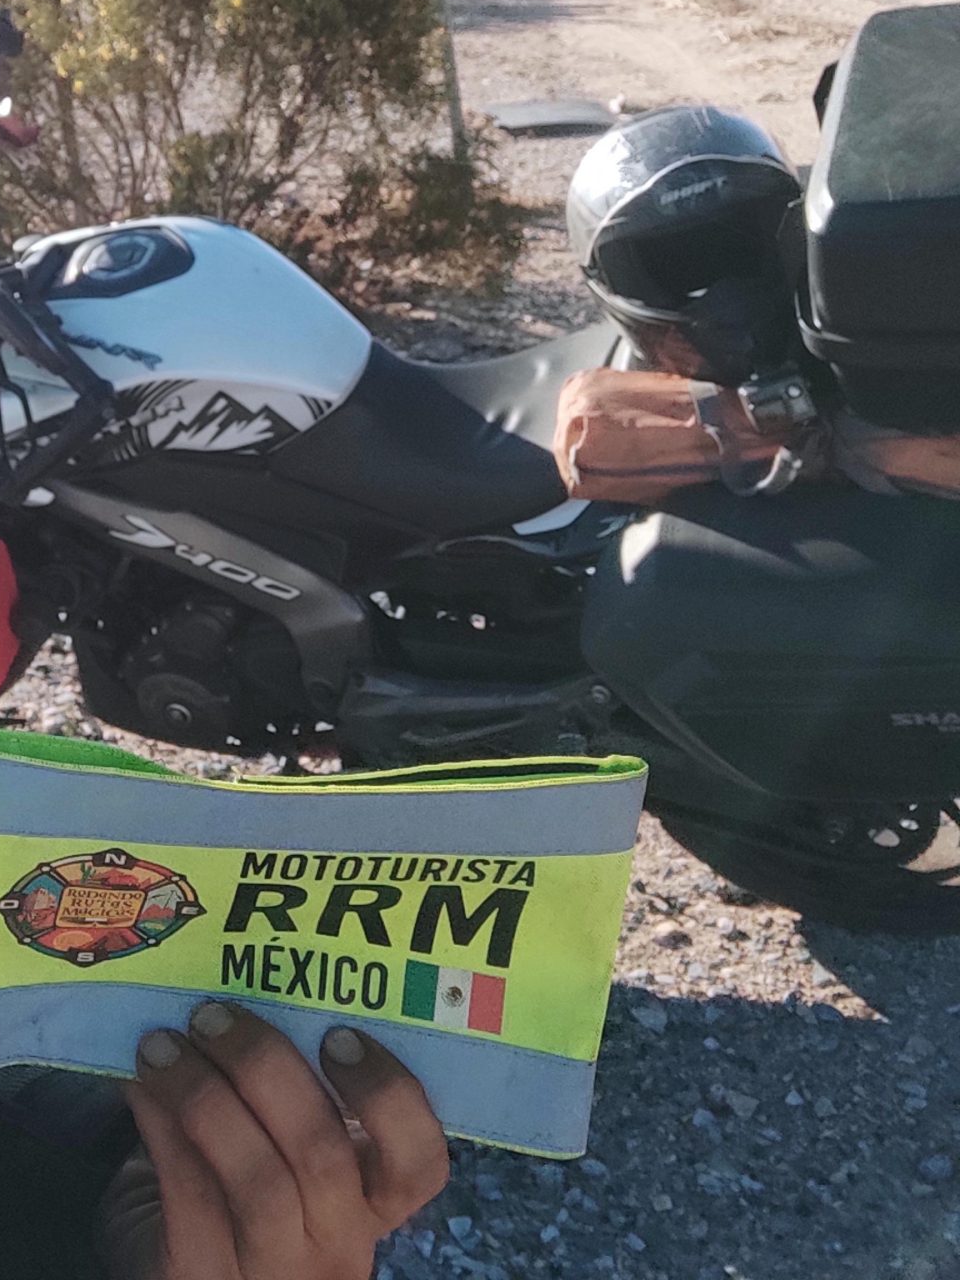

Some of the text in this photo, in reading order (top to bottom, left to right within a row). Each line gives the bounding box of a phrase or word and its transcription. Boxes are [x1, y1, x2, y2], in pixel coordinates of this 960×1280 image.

[104, 852, 127, 866] N
[240, 852, 536, 887] MOTOTURISTA
[223, 882, 530, 969] RRM
[76, 952, 95, 962] S
[221, 937, 388, 1010] MÉXICO
